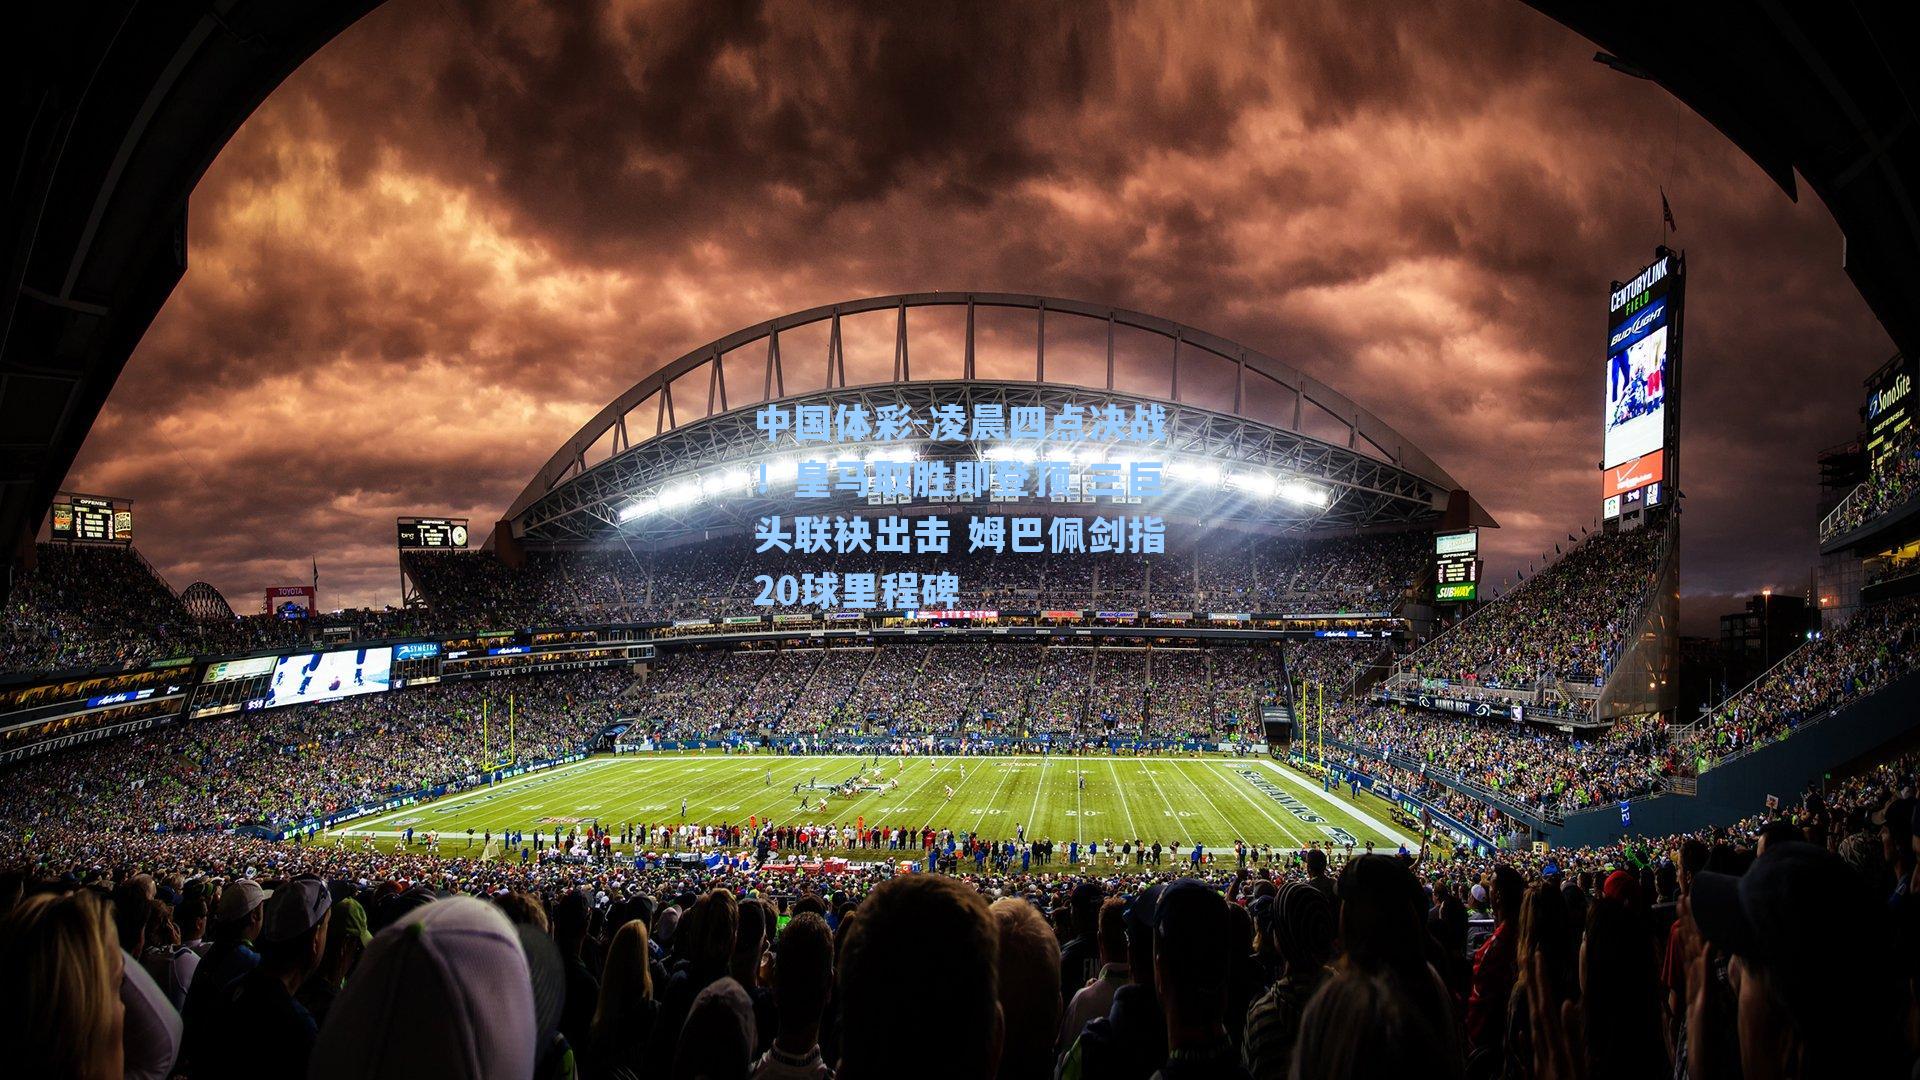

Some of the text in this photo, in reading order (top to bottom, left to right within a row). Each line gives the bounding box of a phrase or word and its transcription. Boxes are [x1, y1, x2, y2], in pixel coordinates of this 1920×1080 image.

[1611, 256, 1669, 312] CENTURYLINK
[1625, 290, 1650, 316] FIELD
[1610, 306, 1664, 346] BUD LIGHT
[1877, 373, 1911, 414] SonoSite
[80, 499, 107, 507] OFFENSE
[401, 532, 415, 540] bing
[278, 587, 303, 596] TOYOTA
[1437, 585, 1474, 598] SUBWAY
[409, 643, 438, 653] SYMETRA
[490, 669, 516, 677] HOME
[538, 664, 555, 672] THE
[561, 662, 583, 670] 12TH
[10, 749, 24, 762] TO
[30, 728, 112, 756] CENTURYLINK
[118, 720, 153, 734] FIELD
[1234, 768, 1329, 823] SEAHAWKS
[1620, 805, 1630, 822] 12
